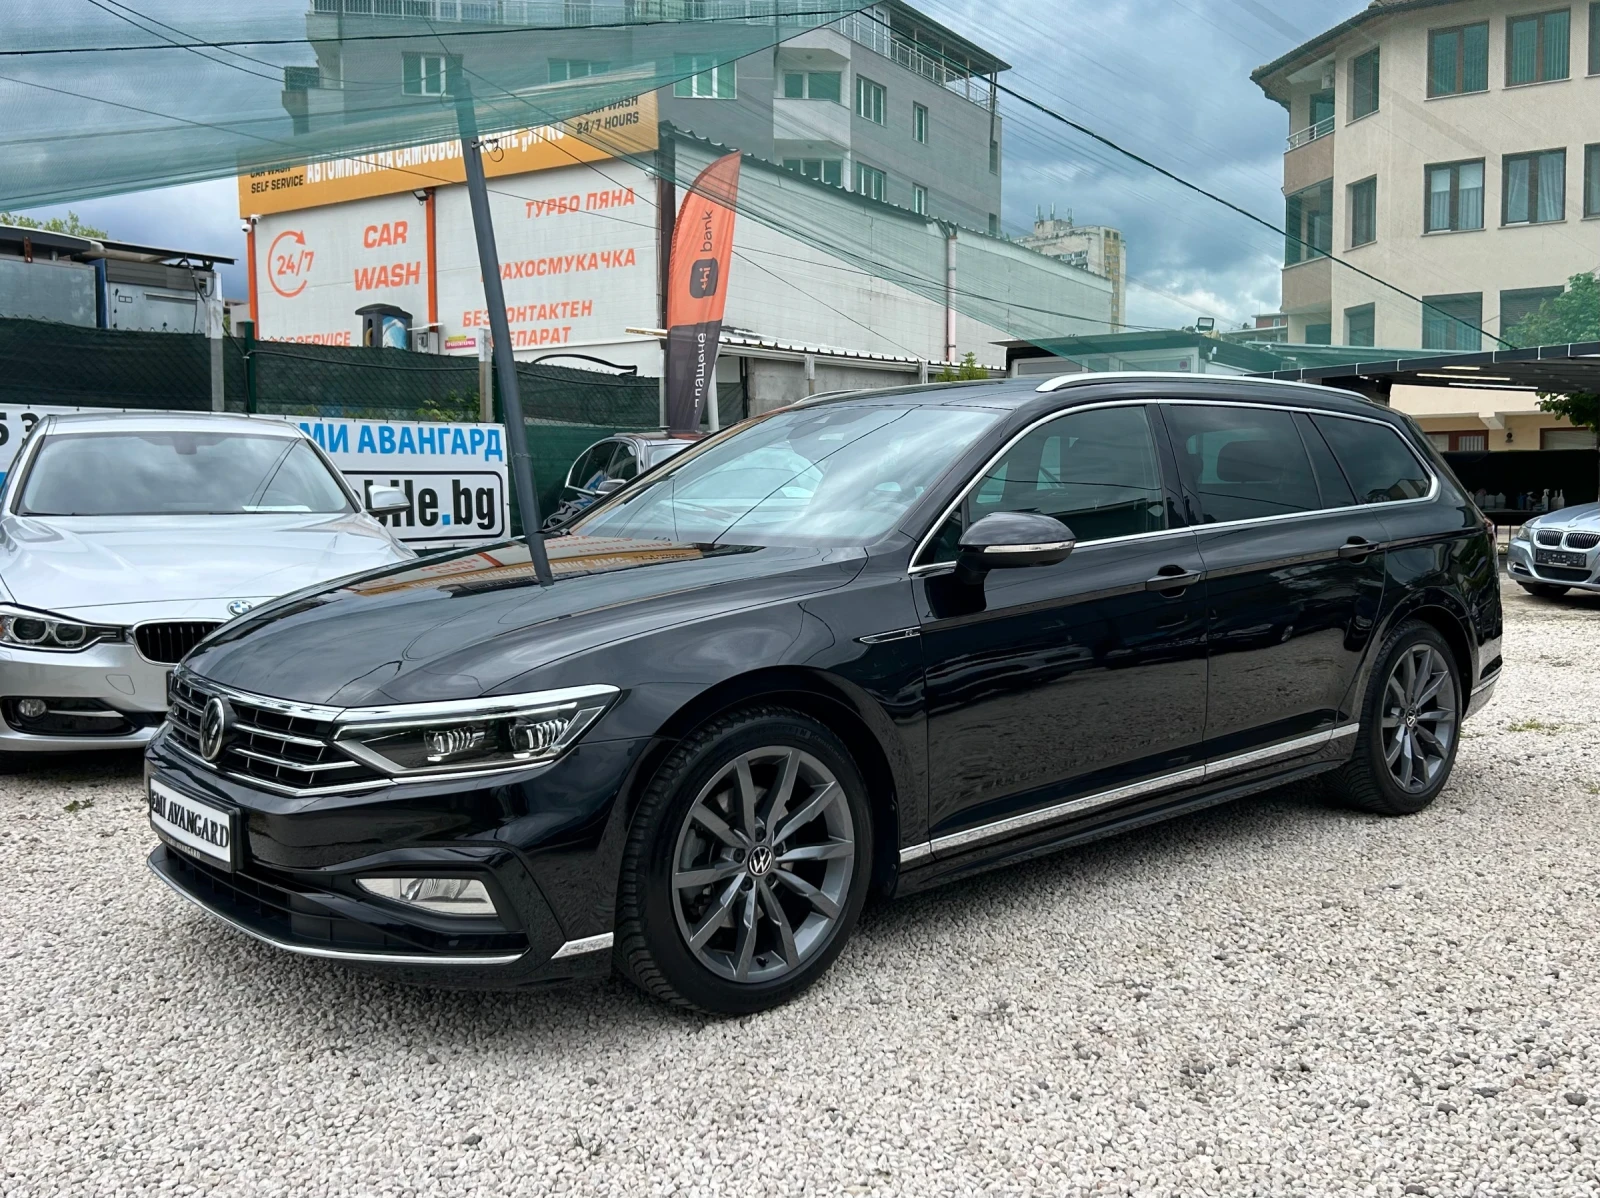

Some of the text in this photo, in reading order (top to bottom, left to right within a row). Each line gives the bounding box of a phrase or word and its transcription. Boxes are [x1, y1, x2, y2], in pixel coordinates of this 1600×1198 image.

[576, 111, 639, 134] 24/7 HOURS
[251, 175, 304, 194] SELF SERVICE
[526, 187, 635, 219] ТУРБО ПЯНА
[363, 221, 408, 248] CAR
[700, 209, 713, 252] bank
[276, 250, 314, 277] 24/7
[354, 261, 421, 291] WASH
[481, 248, 636, 282] АХОСМУКАЧКА
[462, 300, 593, 328] БЕЗОНТАКТЕН
[299, 422, 503, 462] МИ АВАНГАРД
[167, 801, 229, 848] AVANGARD
